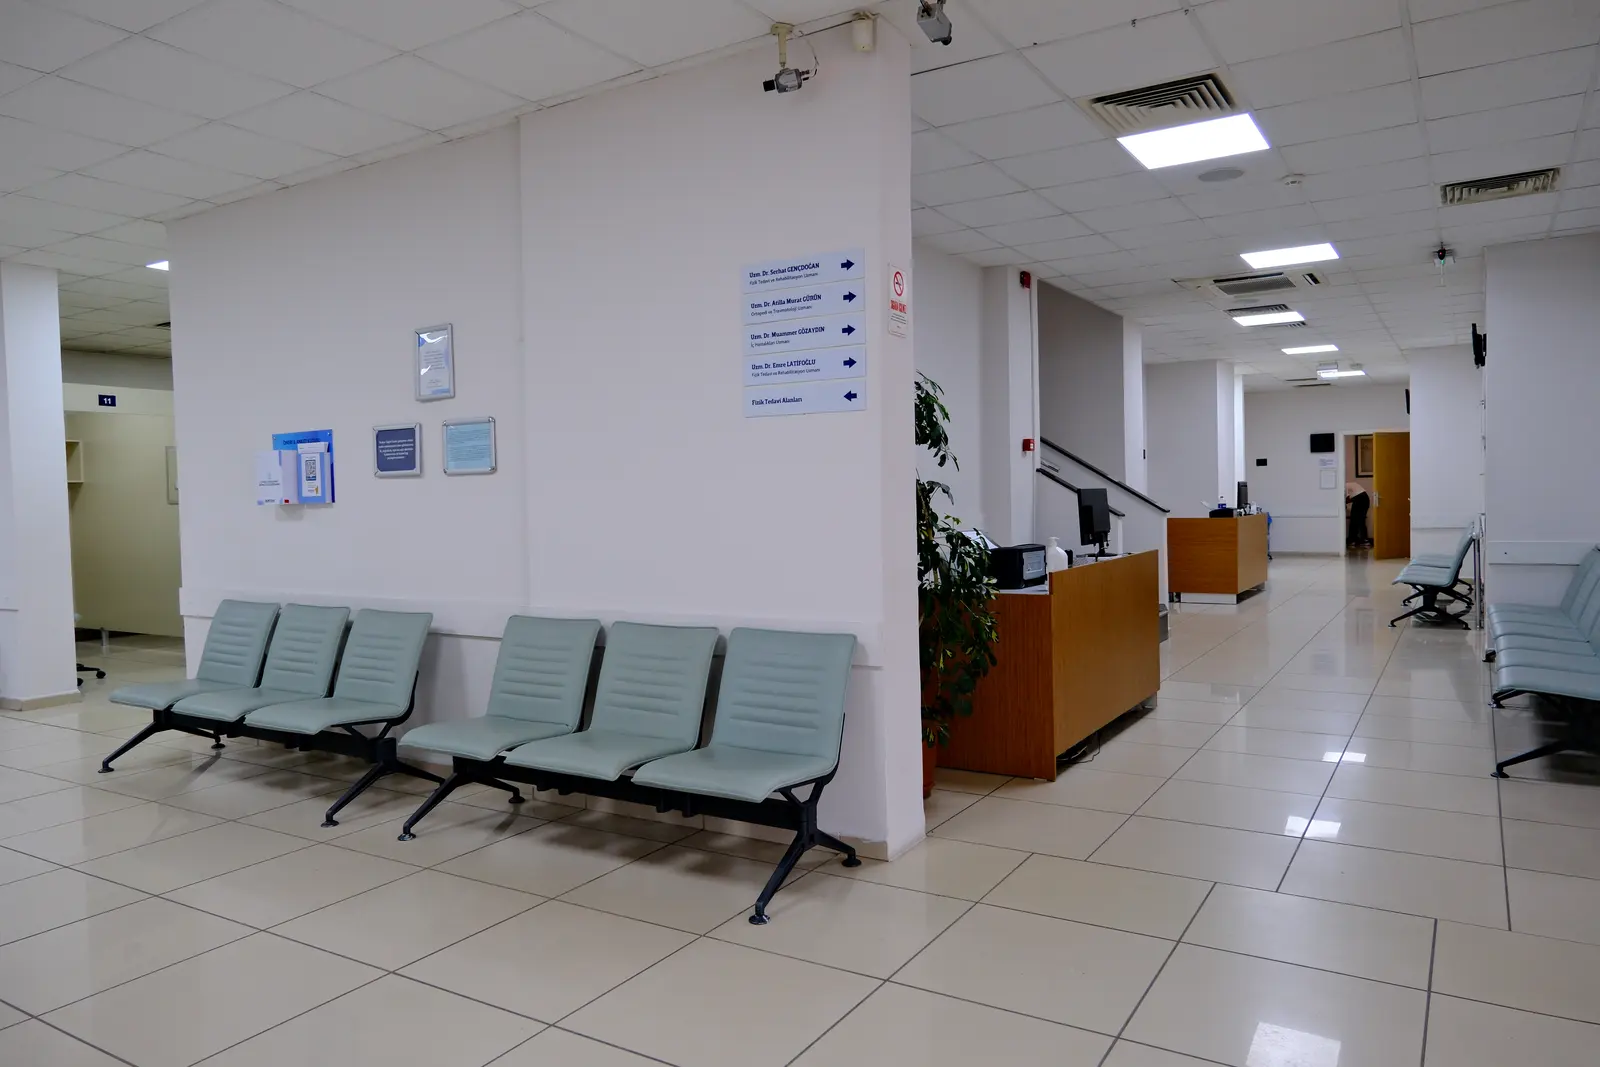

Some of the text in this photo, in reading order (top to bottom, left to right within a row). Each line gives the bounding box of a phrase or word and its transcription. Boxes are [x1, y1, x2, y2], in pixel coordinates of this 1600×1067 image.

[787, 262, 820, 273] GENÇDOĞAN
[798, 326, 825, 335] GÖZAYDIN
[786, 359, 816, 367] LATİFOĞLU
[103, 397, 111, 405] 11
